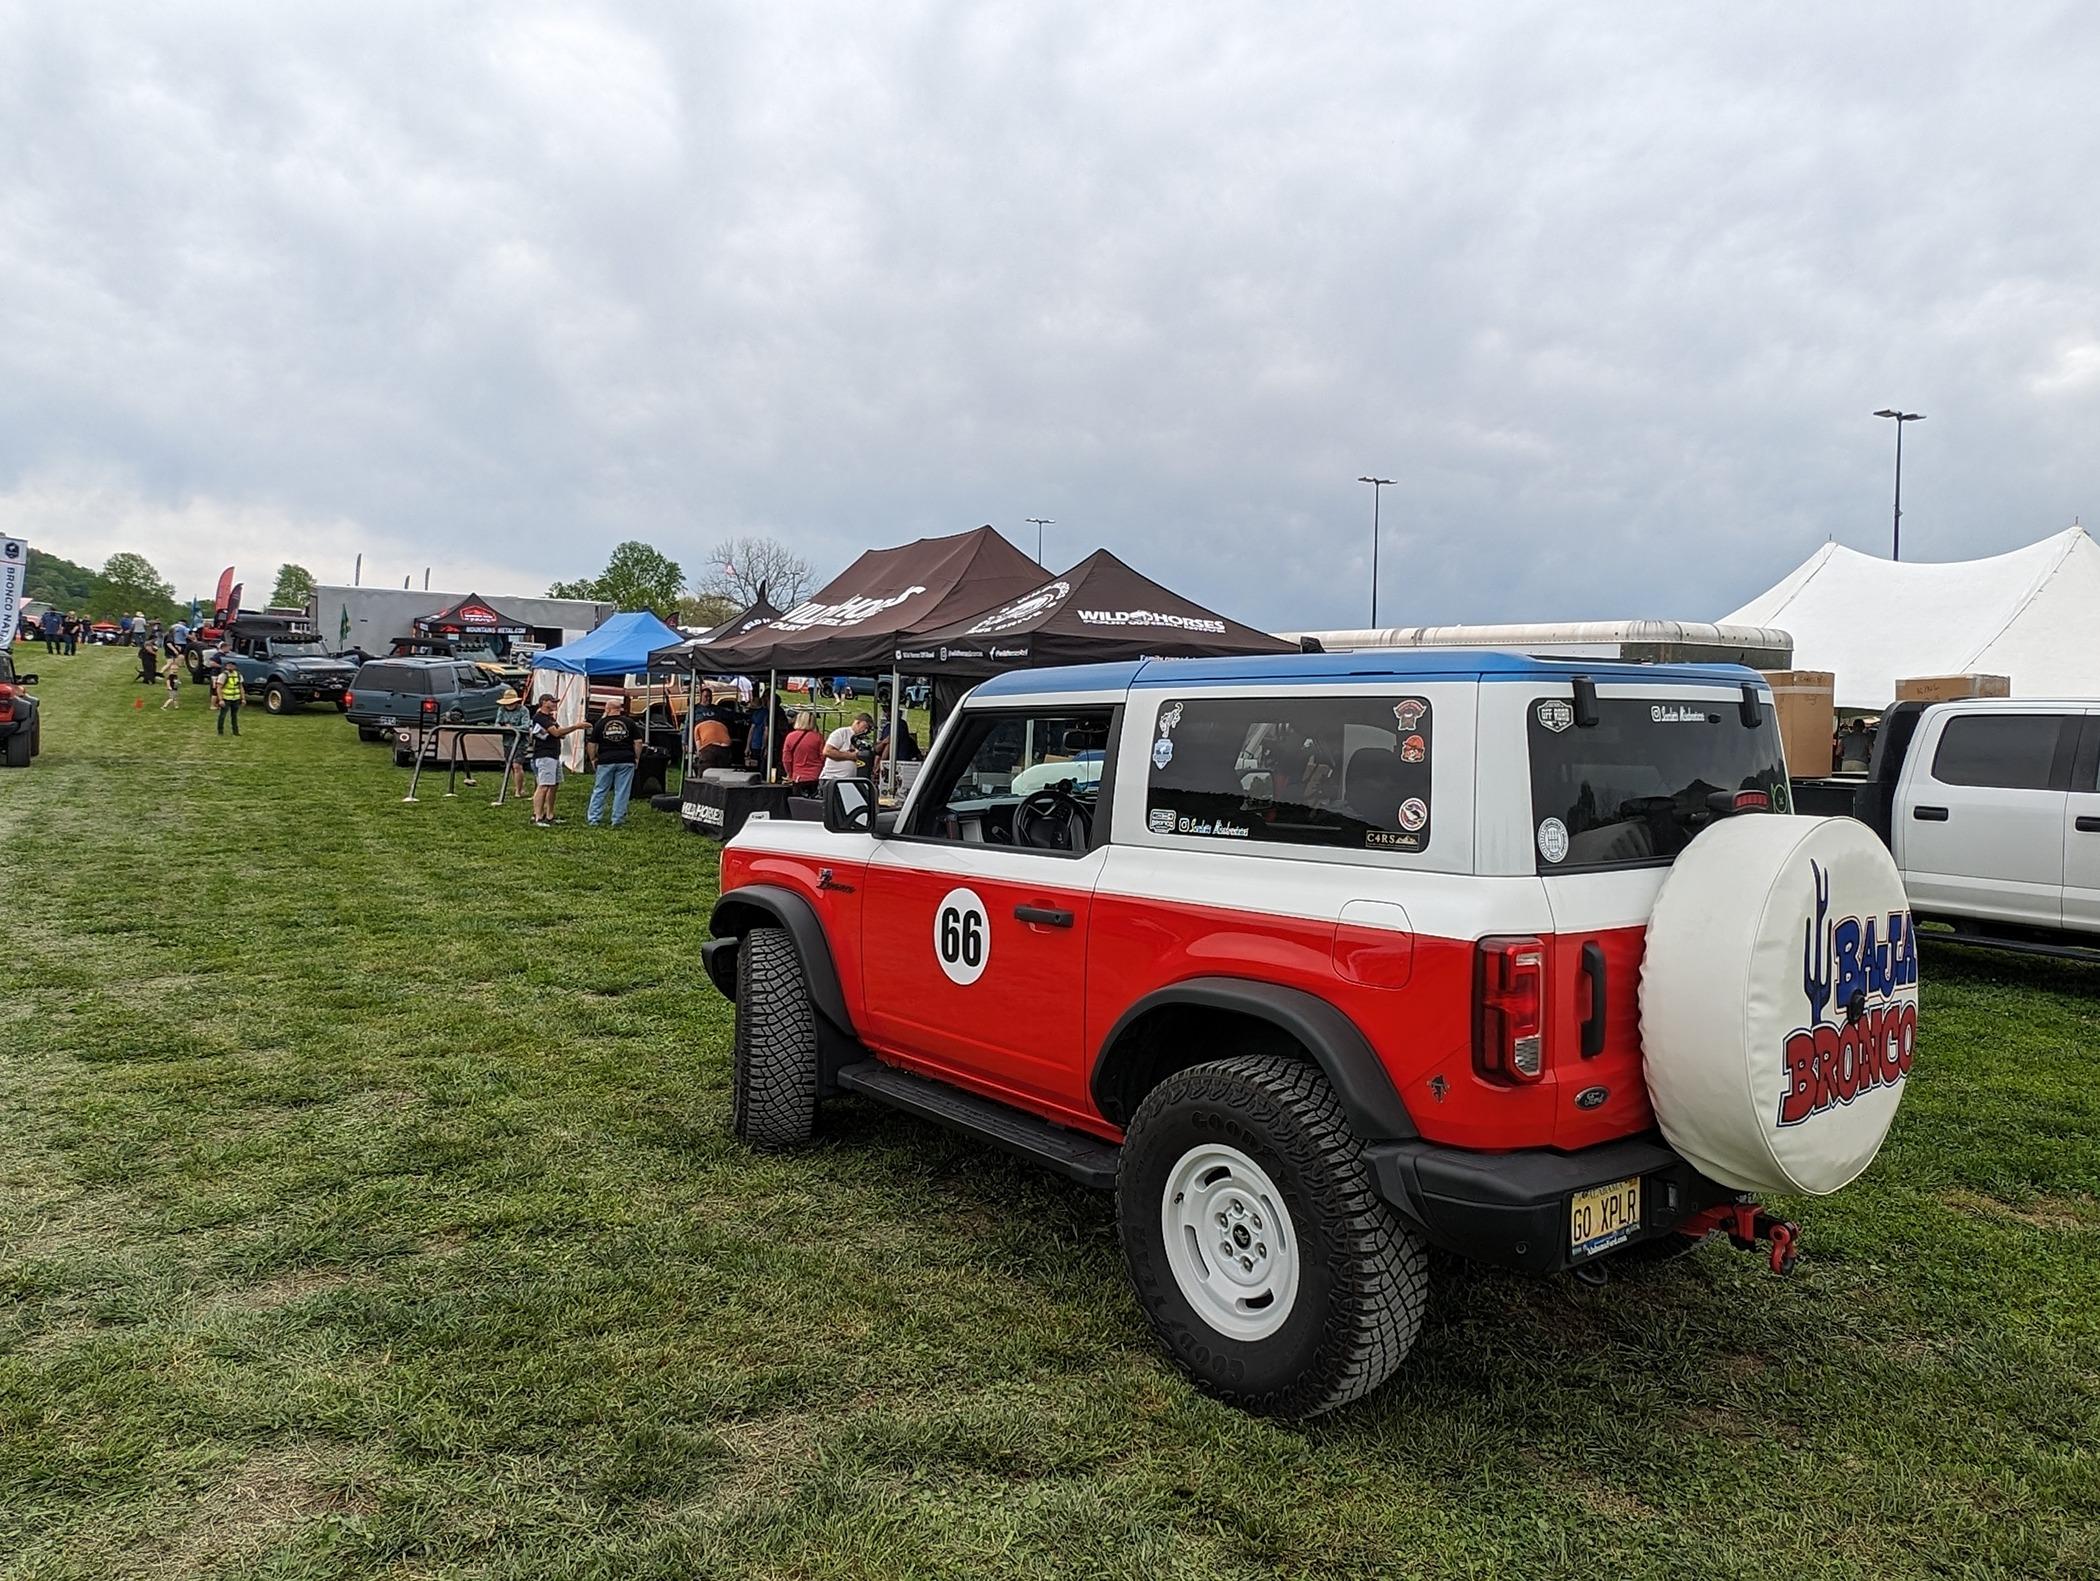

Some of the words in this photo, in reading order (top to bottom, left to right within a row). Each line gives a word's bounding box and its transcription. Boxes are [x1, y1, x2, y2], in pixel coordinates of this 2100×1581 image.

[4, 567, 15, 611] BRONCO
[1077, 610, 1129, 621] WILD
[1152, 612, 1225, 630] HORSES
[1367, 833, 1396, 844] C4RS
[941, 907, 983, 968] 66
[1832, 911, 1917, 1014] BAJA
[1776, 1000, 1917, 1128] BRONCO
[1573, 1205, 1592, 1242] GO
[1601, 1189, 1637, 1232] XPLR
